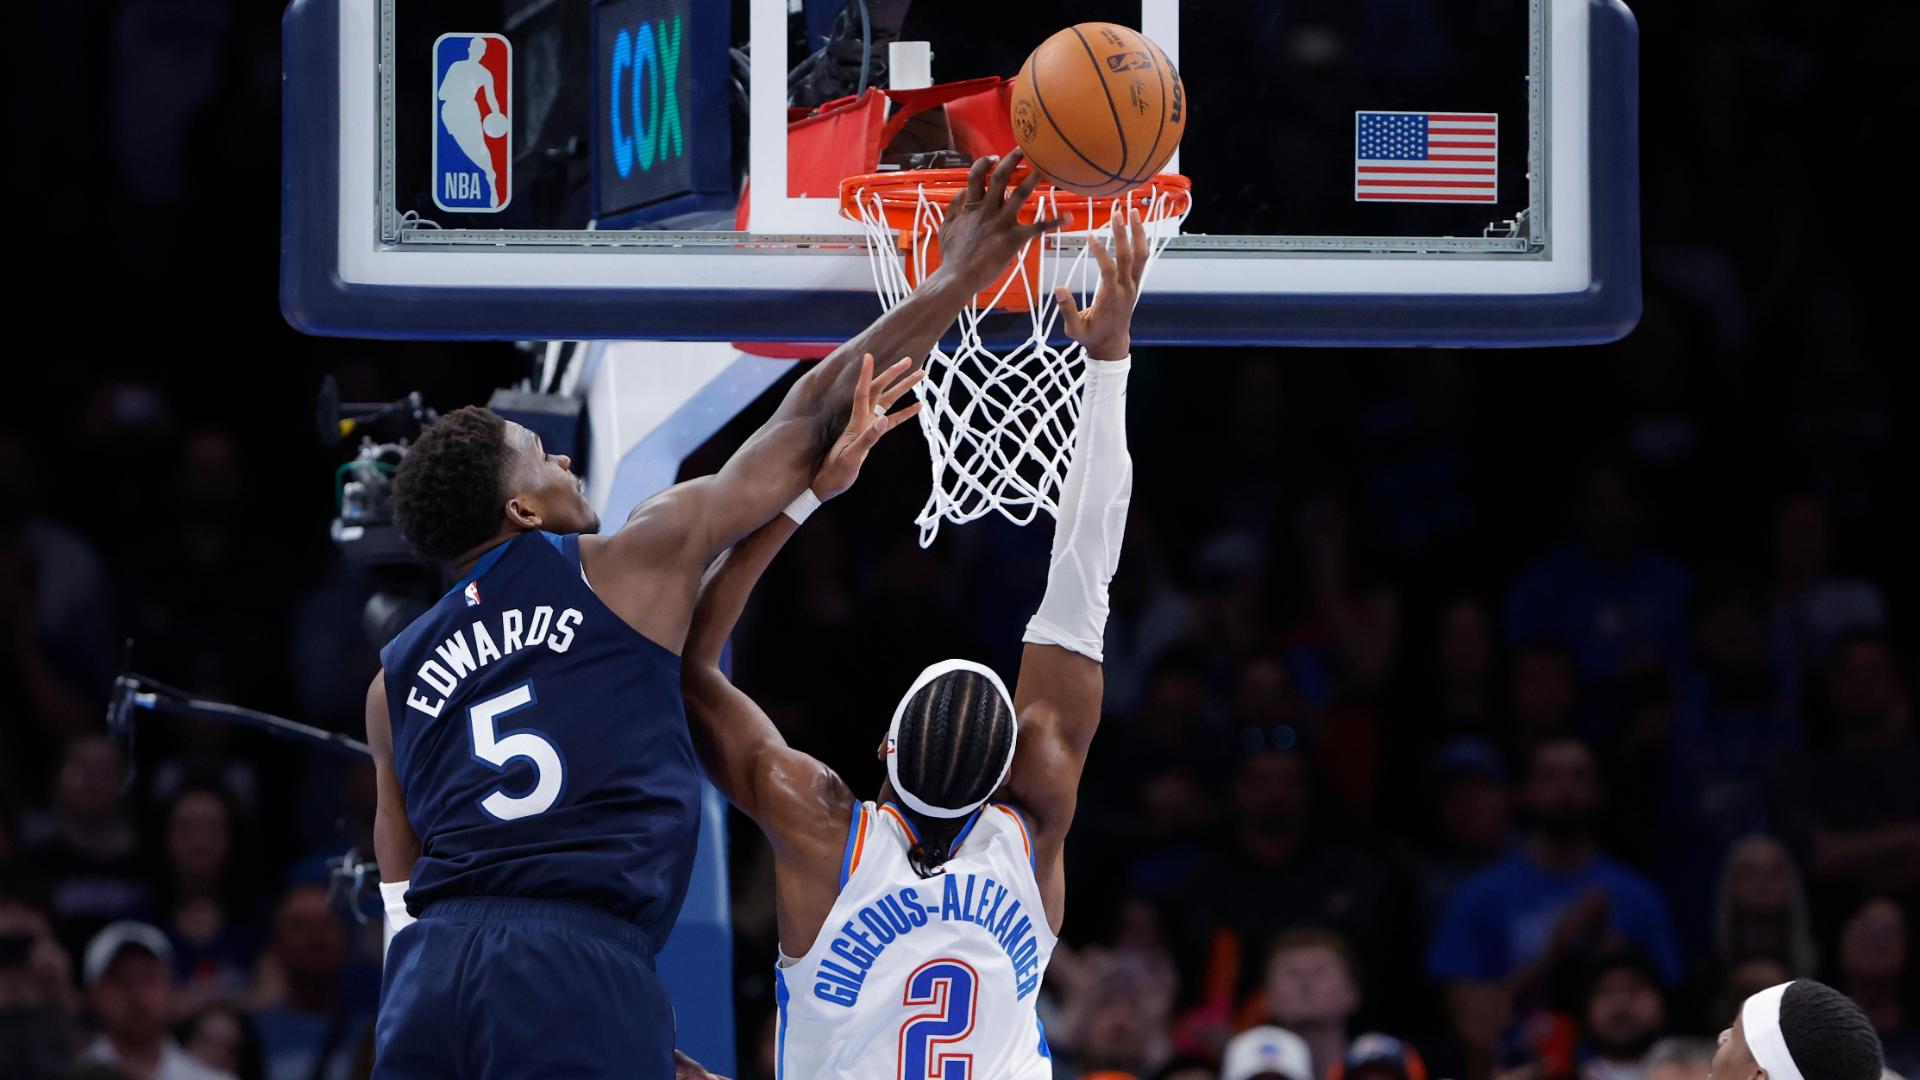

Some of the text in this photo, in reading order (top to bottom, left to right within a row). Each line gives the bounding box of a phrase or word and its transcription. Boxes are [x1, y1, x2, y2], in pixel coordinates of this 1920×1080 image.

[611, 14, 682, 180] COX
[445, 172, 481, 200] NBA
[406, 605, 584, 718] EDWARDS
[465, 679, 568, 821] 5
[813, 873, 1039, 1008] GILGEOUS-ALEXANDER
[897, 958, 979, 1080] 2
